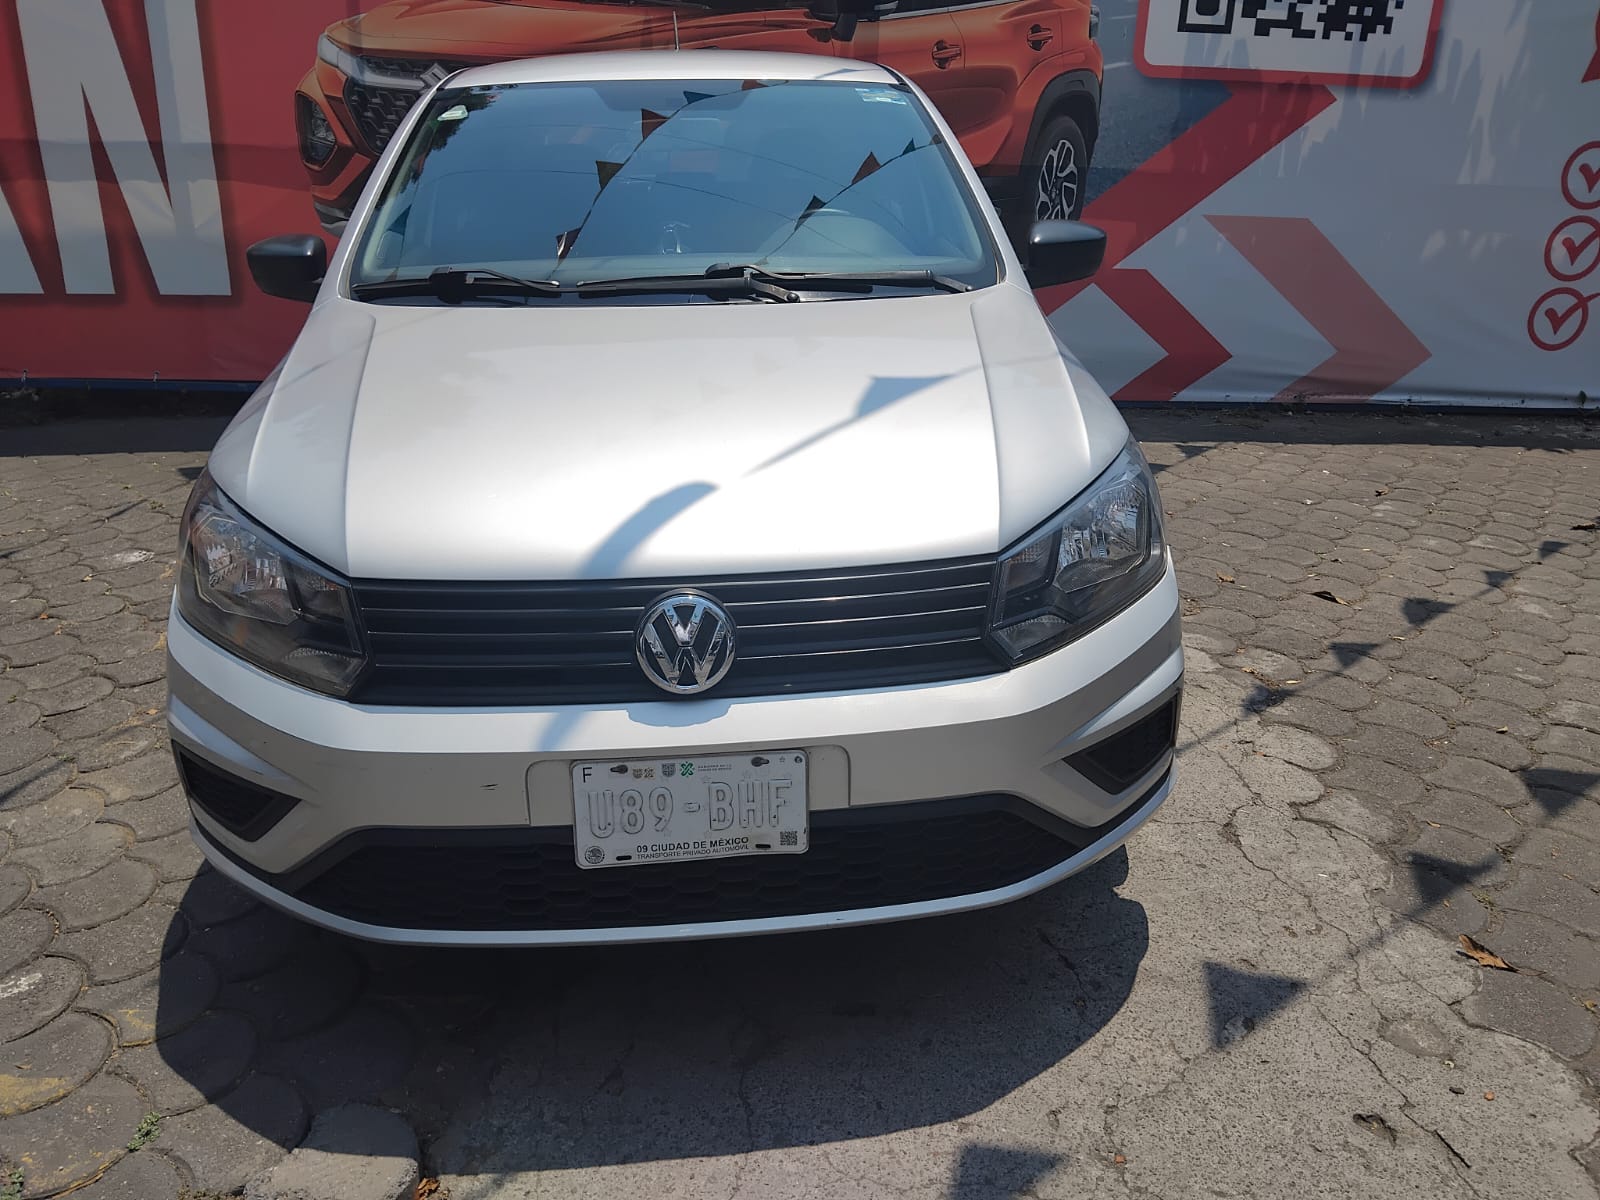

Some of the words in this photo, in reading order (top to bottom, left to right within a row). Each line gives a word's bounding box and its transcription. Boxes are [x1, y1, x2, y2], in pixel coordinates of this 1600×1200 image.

[582, 766, 593, 784] F
[587, 778, 793, 839] U89-BHF
[636, 844, 648, 853] 09
[650, 842, 690, 852] CIUDAD
[693, 840, 707, 849] DE
[709, 836, 749, 847] MÉXICO
[637, 850, 681, 860] TRANSPORTE
[682, 848, 711, 856] PRIVADO
